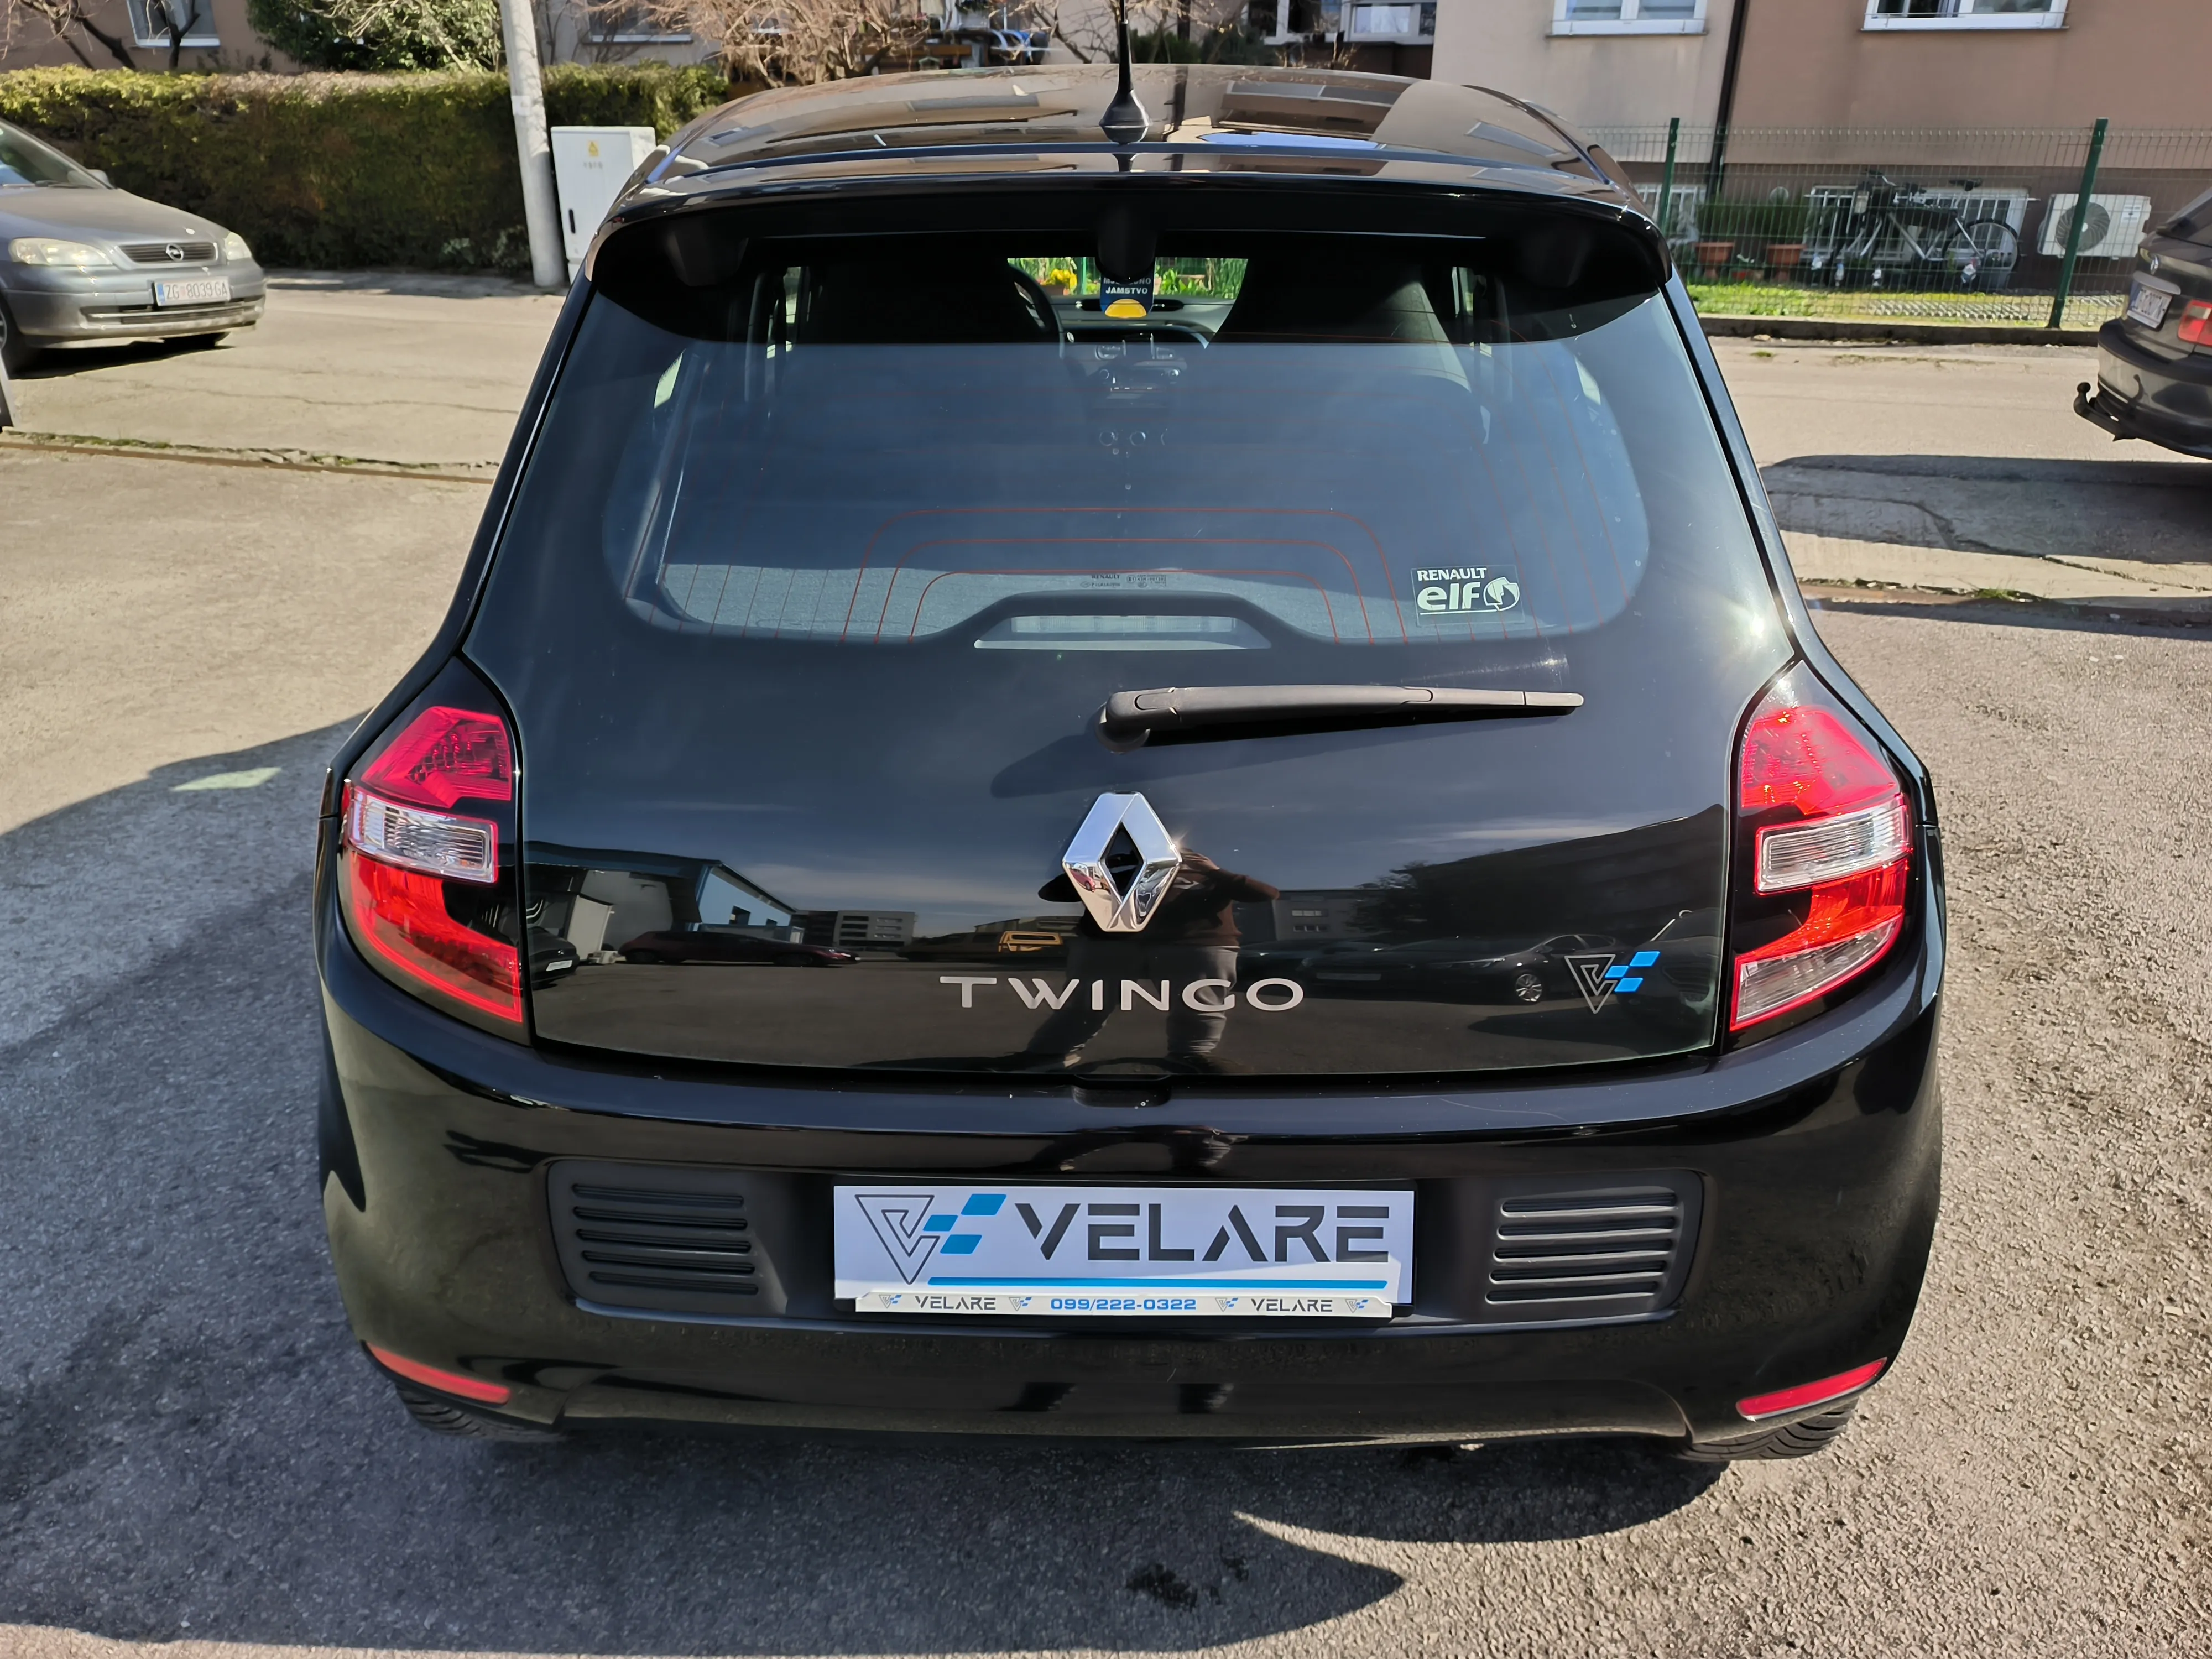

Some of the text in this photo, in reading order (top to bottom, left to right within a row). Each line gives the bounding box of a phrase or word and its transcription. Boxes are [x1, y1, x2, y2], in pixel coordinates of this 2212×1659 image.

[165, 284, 179, 299] ZG
[1417, 567, 1487, 581] RENAULT
[1417, 582, 1480, 611] elf
[940, 976, 1304, 1011] TWINGO
[1015, 1203, 1389, 1263] VELARE
[915, 1296, 1333, 1312] VELARE 099/222-0322 VELARE
